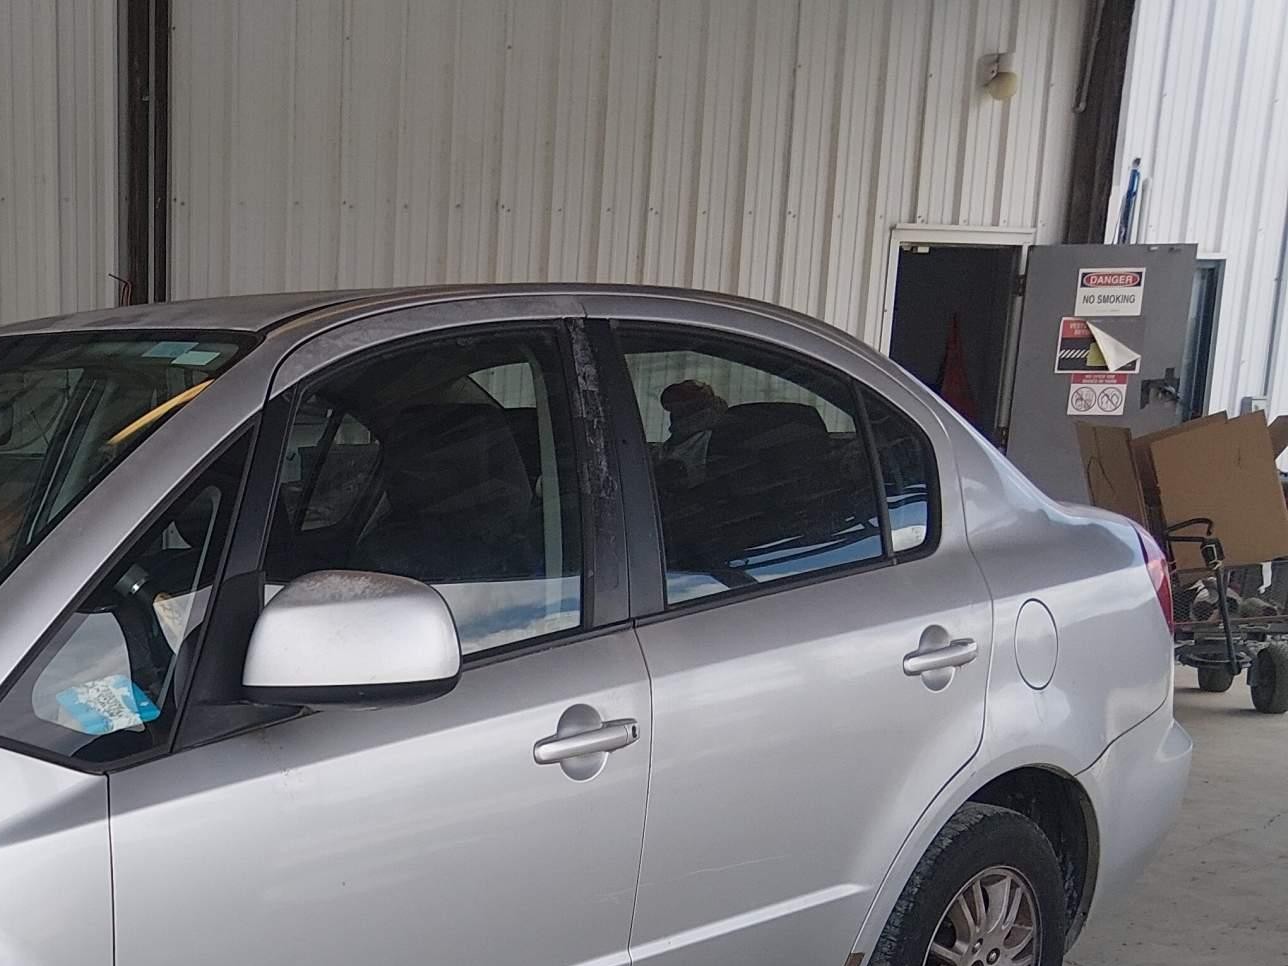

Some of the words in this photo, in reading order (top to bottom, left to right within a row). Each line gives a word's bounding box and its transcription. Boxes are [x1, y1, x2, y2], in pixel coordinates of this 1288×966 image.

[1090, 275, 1133, 284] DANGER
[1082, 294, 1095, 304] NO
[1097, 294, 1135, 304] SMOKING
